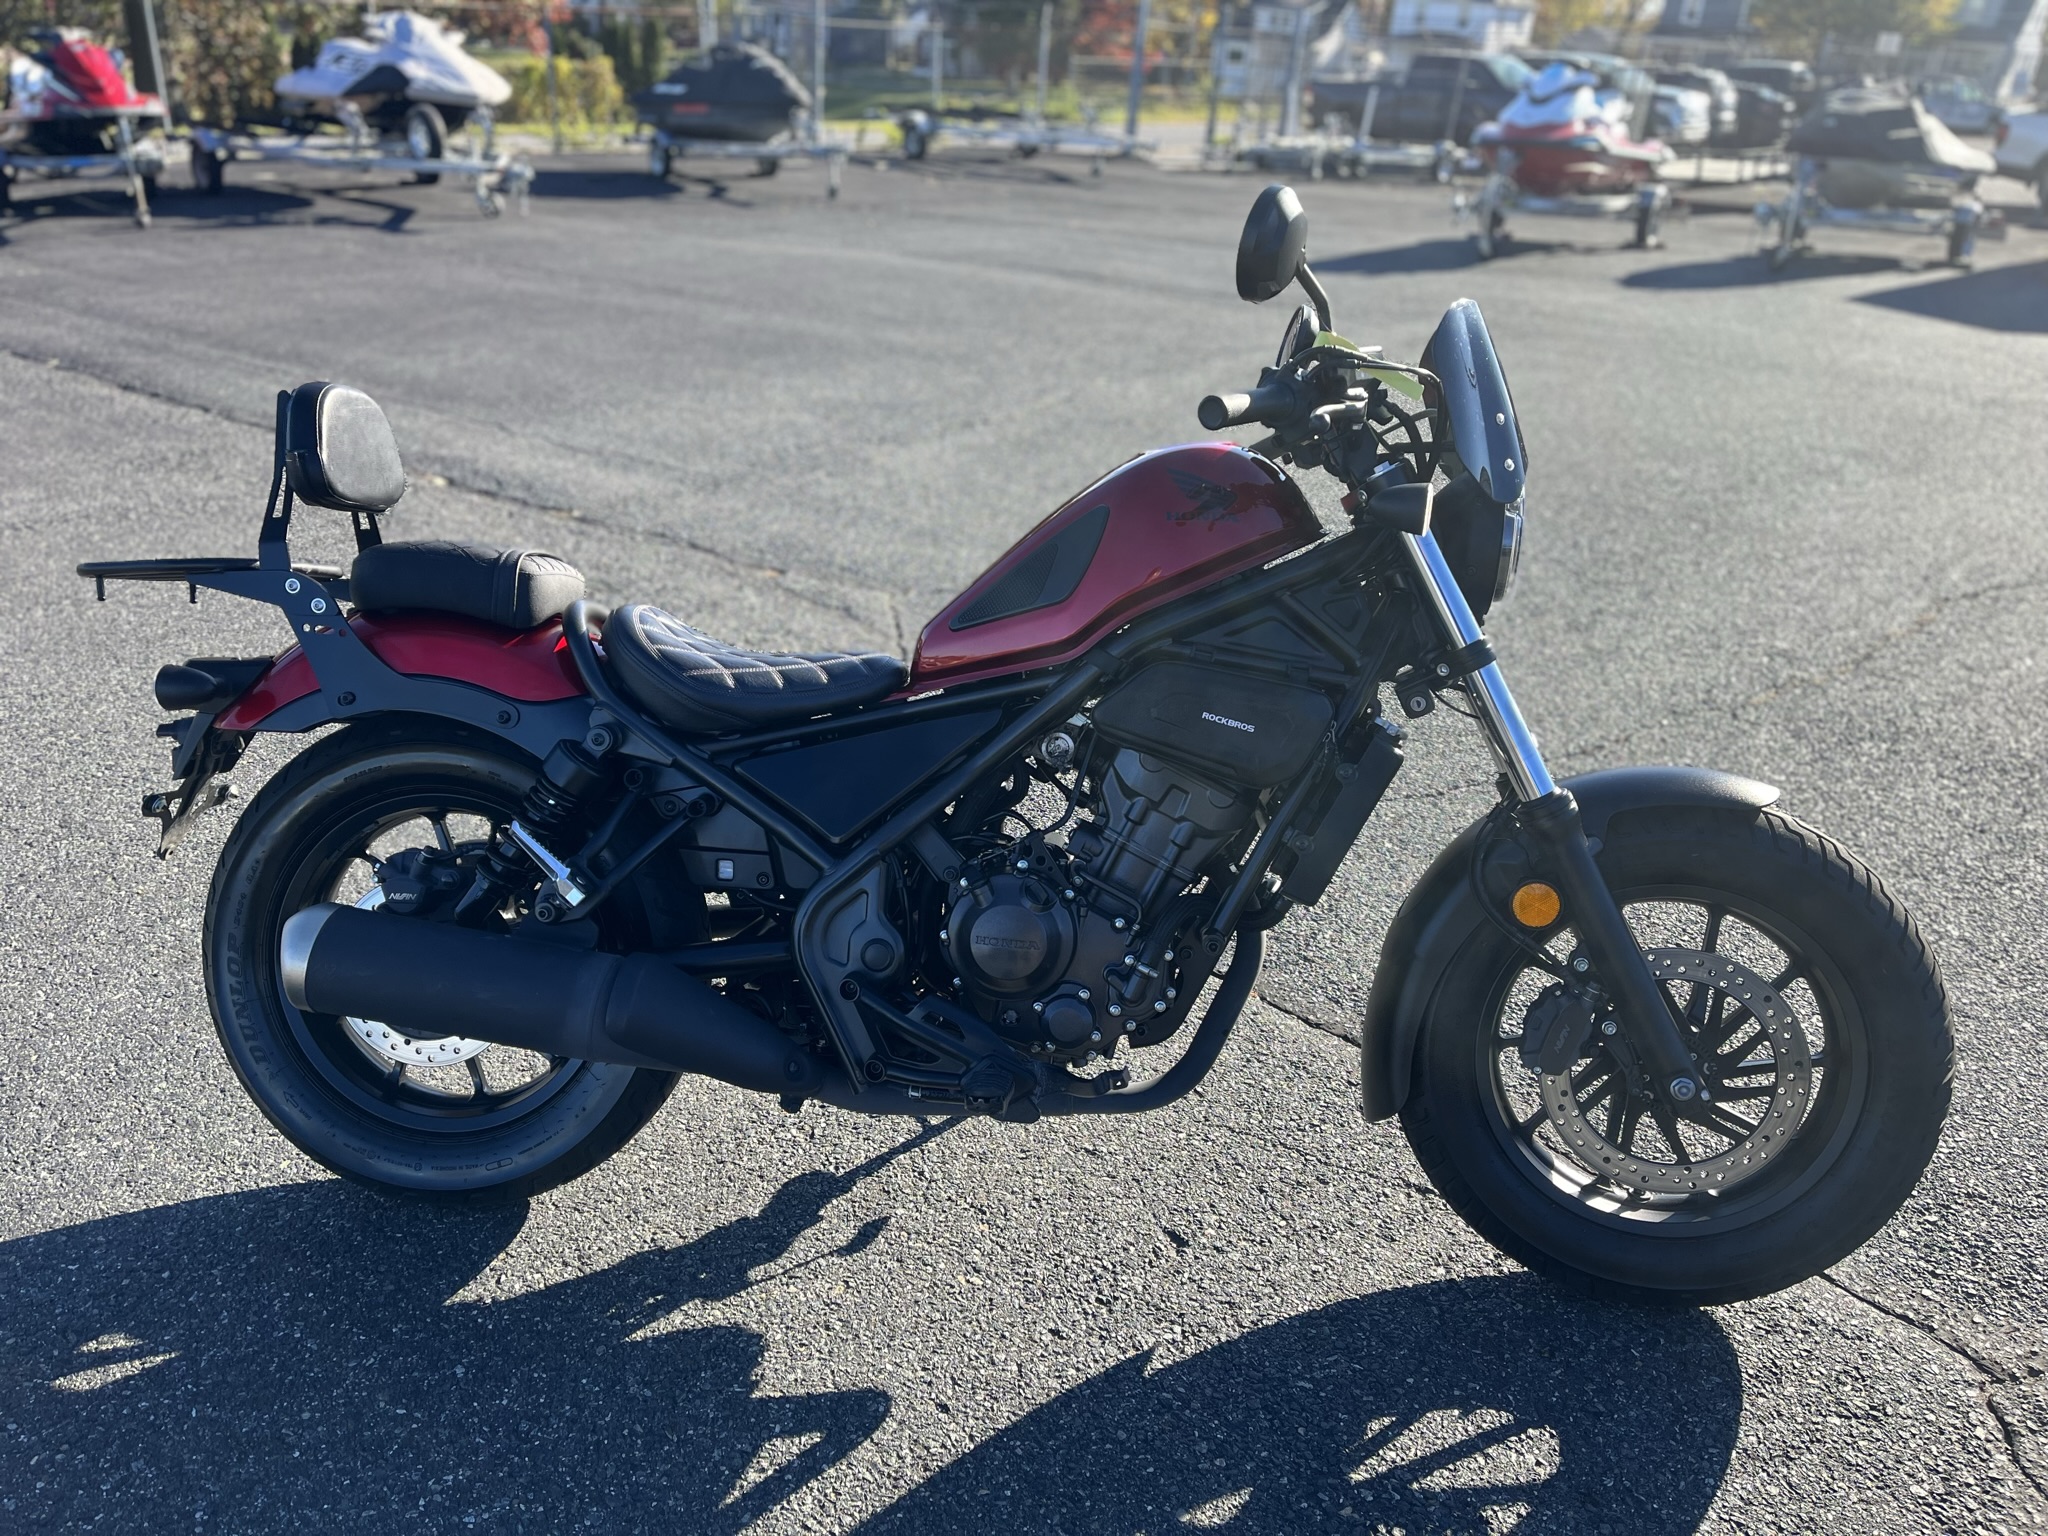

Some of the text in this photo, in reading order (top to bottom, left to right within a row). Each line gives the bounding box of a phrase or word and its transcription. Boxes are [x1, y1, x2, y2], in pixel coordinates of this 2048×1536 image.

[1166, 511, 1240, 523] HONDA
[1201, 711, 1256, 733] ROCKBROS
[975, 935, 1040, 950] HONDA
[226, 931, 272, 1066] DUNLOP
